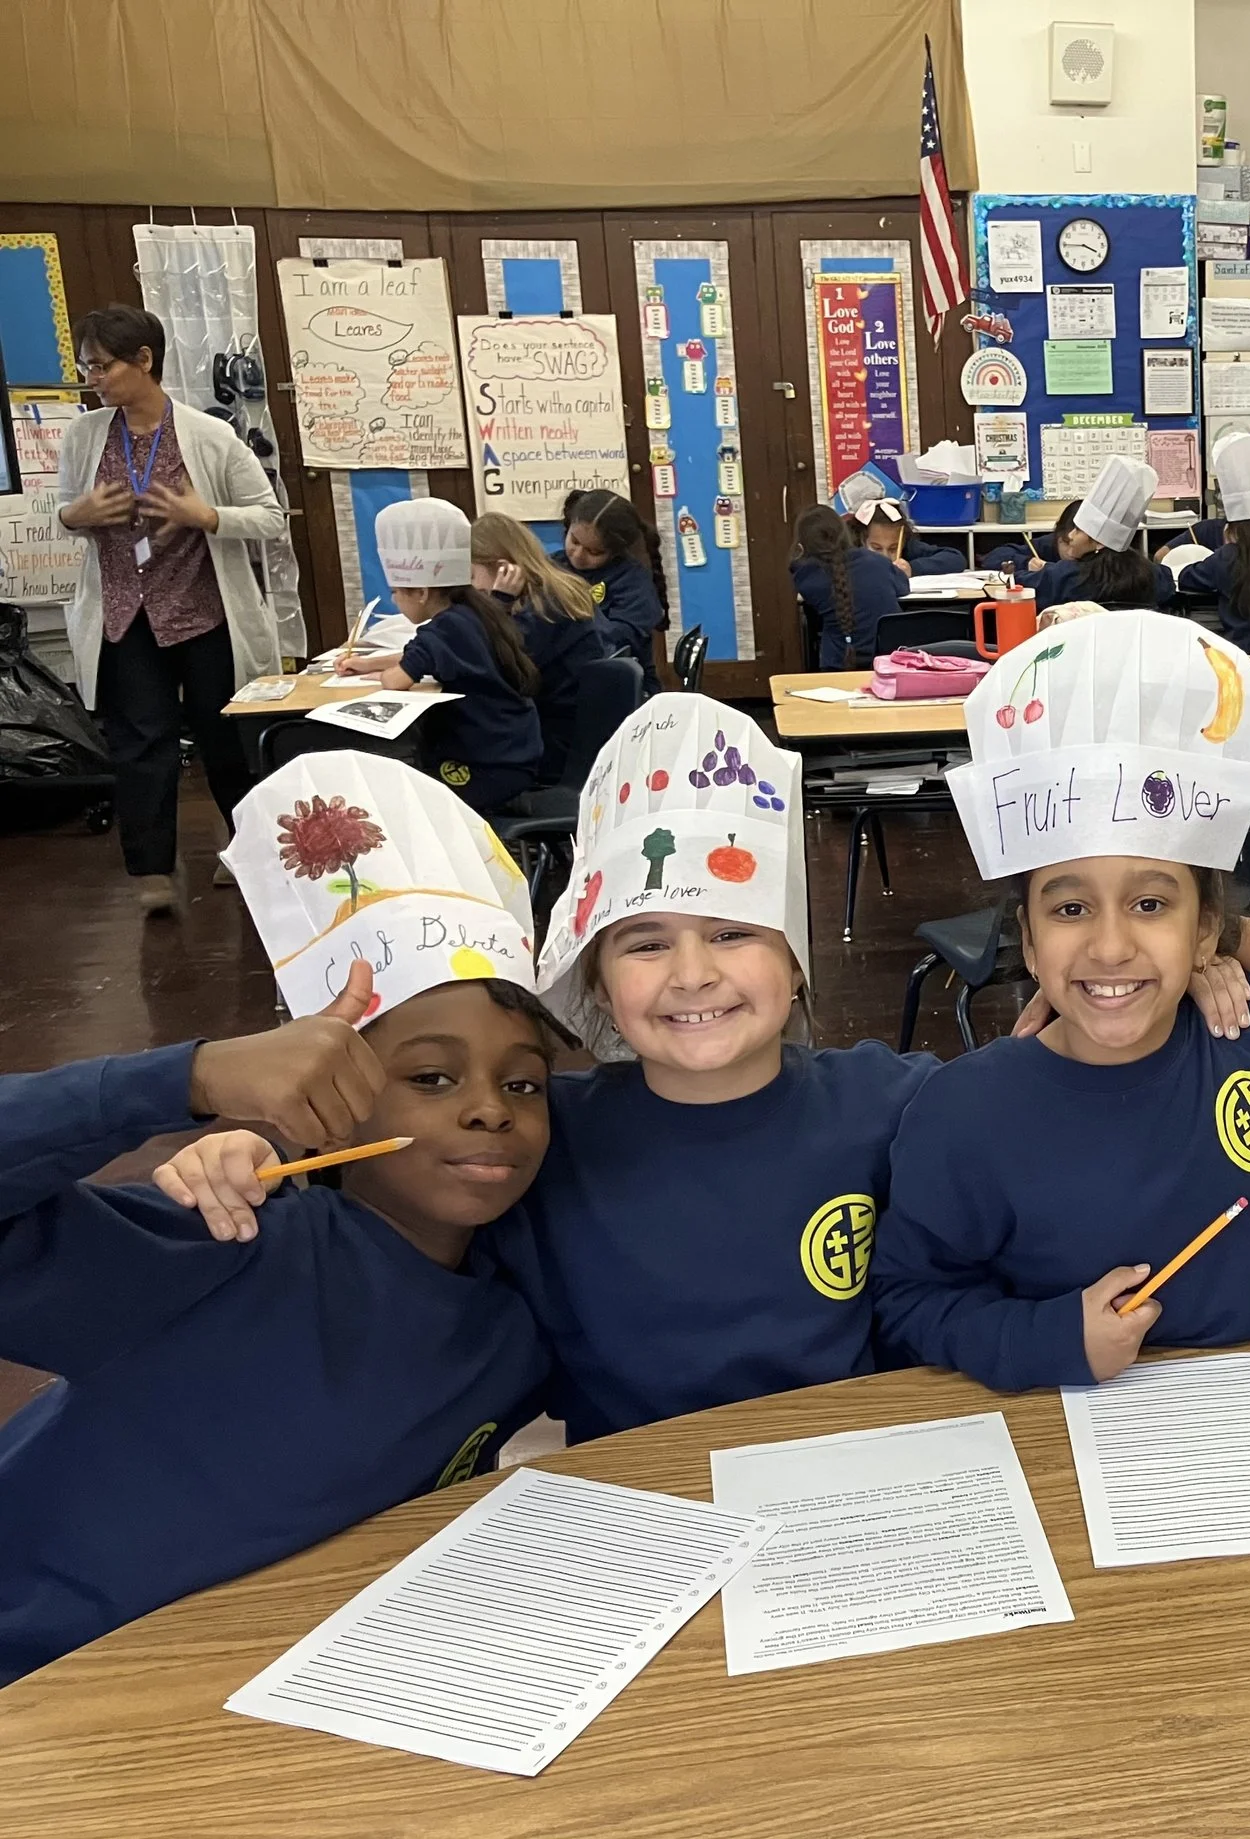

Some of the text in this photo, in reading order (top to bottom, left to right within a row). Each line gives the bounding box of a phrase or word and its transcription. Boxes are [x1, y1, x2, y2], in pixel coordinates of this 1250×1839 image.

[1240, 263, 1249, 275] of
[293, 267, 422, 297] I am a leaf
[1000, 275, 1033, 285] yux4934
[835, 288, 845, 301] 1
[823, 298, 859, 318] Love
[828, 320, 854, 334] God
[874, 321, 885, 333] 2
[480, 338, 595, 357] Does your sentence
[865, 331, 896, 350] Love
[497, 350, 598, 375] have SWAG?
[864, 353, 899, 365] others
[575, 389, 614, 418] capital
[401, 413, 434, 429] I can
[1073, 415, 1124, 425] DECEMBER
[408, 428, 464, 443] identify the
[540, 417, 579, 446] neatly
[986, 433, 1018, 443] CHRISTMAS
[483, 442, 502, 467] A
[502, 449, 542, 471] space
[544, 442, 598, 462] between
[545, 468, 620, 500] punctuation
[8, 516, 53, 545] I read
[8, 549, 30, 571] The
[22, 576, 49, 597] know
[993, 767, 1081, 855] Fruit
[663, 884, 708, 899] lover
